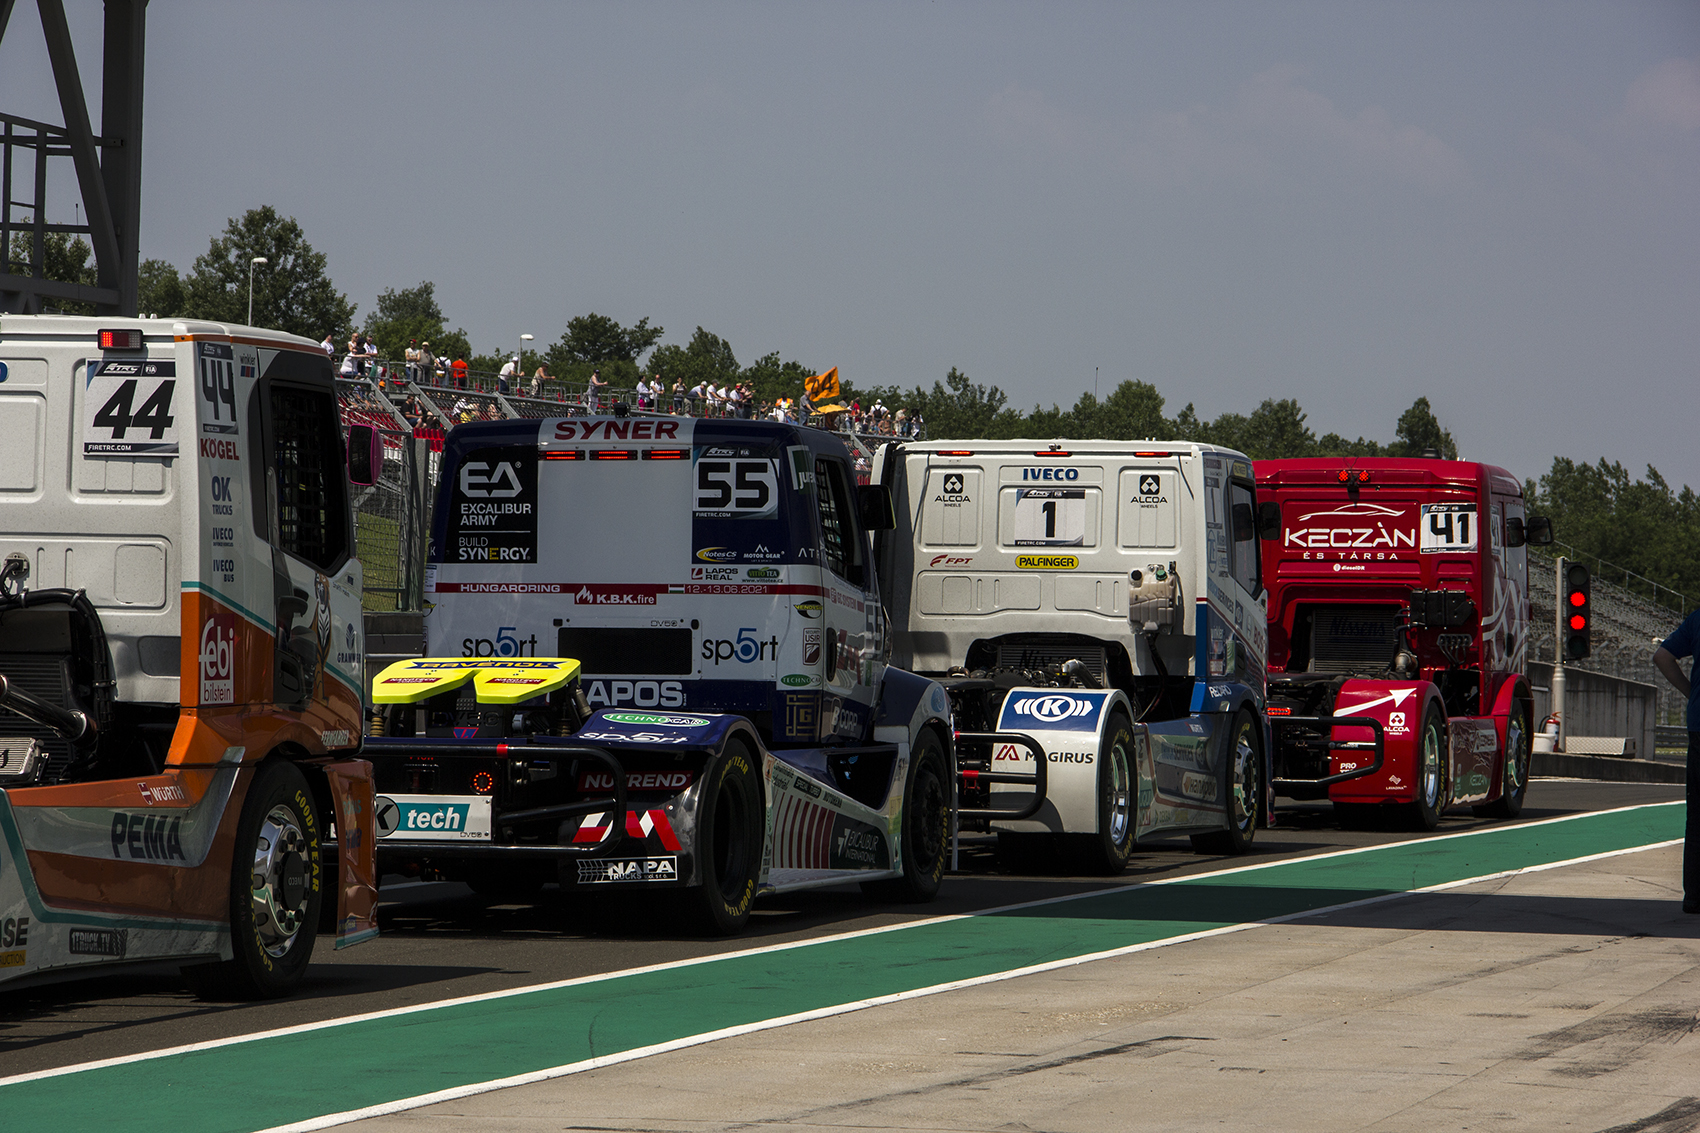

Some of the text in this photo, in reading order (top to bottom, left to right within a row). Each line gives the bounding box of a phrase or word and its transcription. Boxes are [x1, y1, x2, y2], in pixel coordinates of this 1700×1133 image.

[201, 357, 237, 422] 44
[92, 379, 176, 440] 44
[554, 420, 679, 440] SYNER
[200, 436, 240, 461] KÖGEL
[1024, 466, 1079, 482] IVECO
[212, 475, 232, 502] OK
[698, 462, 769, 508] 55
[934, 496, 972, 504] ALCOA
[1131, 497, 1169, 505] ALCOA
[212, 504, 233, 516] TRUCKS
[461, 503, 532, 514] EXCALIBUR
[696, 512, 731, 520] FIRETRC.COM
[460, 515, 498, 526] ARMY
[1043, 502, 1056, 538] 1
[213, 527, 234, 541] IVECO
[1430, 512, 1470, 545] 41
[459, 537, 489, 548] BUILD
[946, 556, 974, 566] FPT
[1019, 556, 1075, 568] PALFINGER
[1303, 550, 1399, 561] ÉS TÁRSA
[213, 559, 235, 573] IVECO
[223, 573, 235, 583] BUS
[460, 583, 560, 593] HUNGARORING
[686, 584, 768, 594] 12.-13.06.2021
[199, 617, 234, 679] febi
[203, 682, 231, 702] bilstein
[586, 680, 684, 708] APOS
[1041, 699, 1067, 716] K
[1025, 751, 1094, 764] MGIRUS
[149, 785, 185, 802] WÜRTH
[407, 807, 460, 829] tech
[111, 812, 186, 861] PEMA
[294, 790, 320, 893] GOODYEAR
[607, 859, 676, 874] NAPA
[608, 872, 642, 881] TRUCKS
